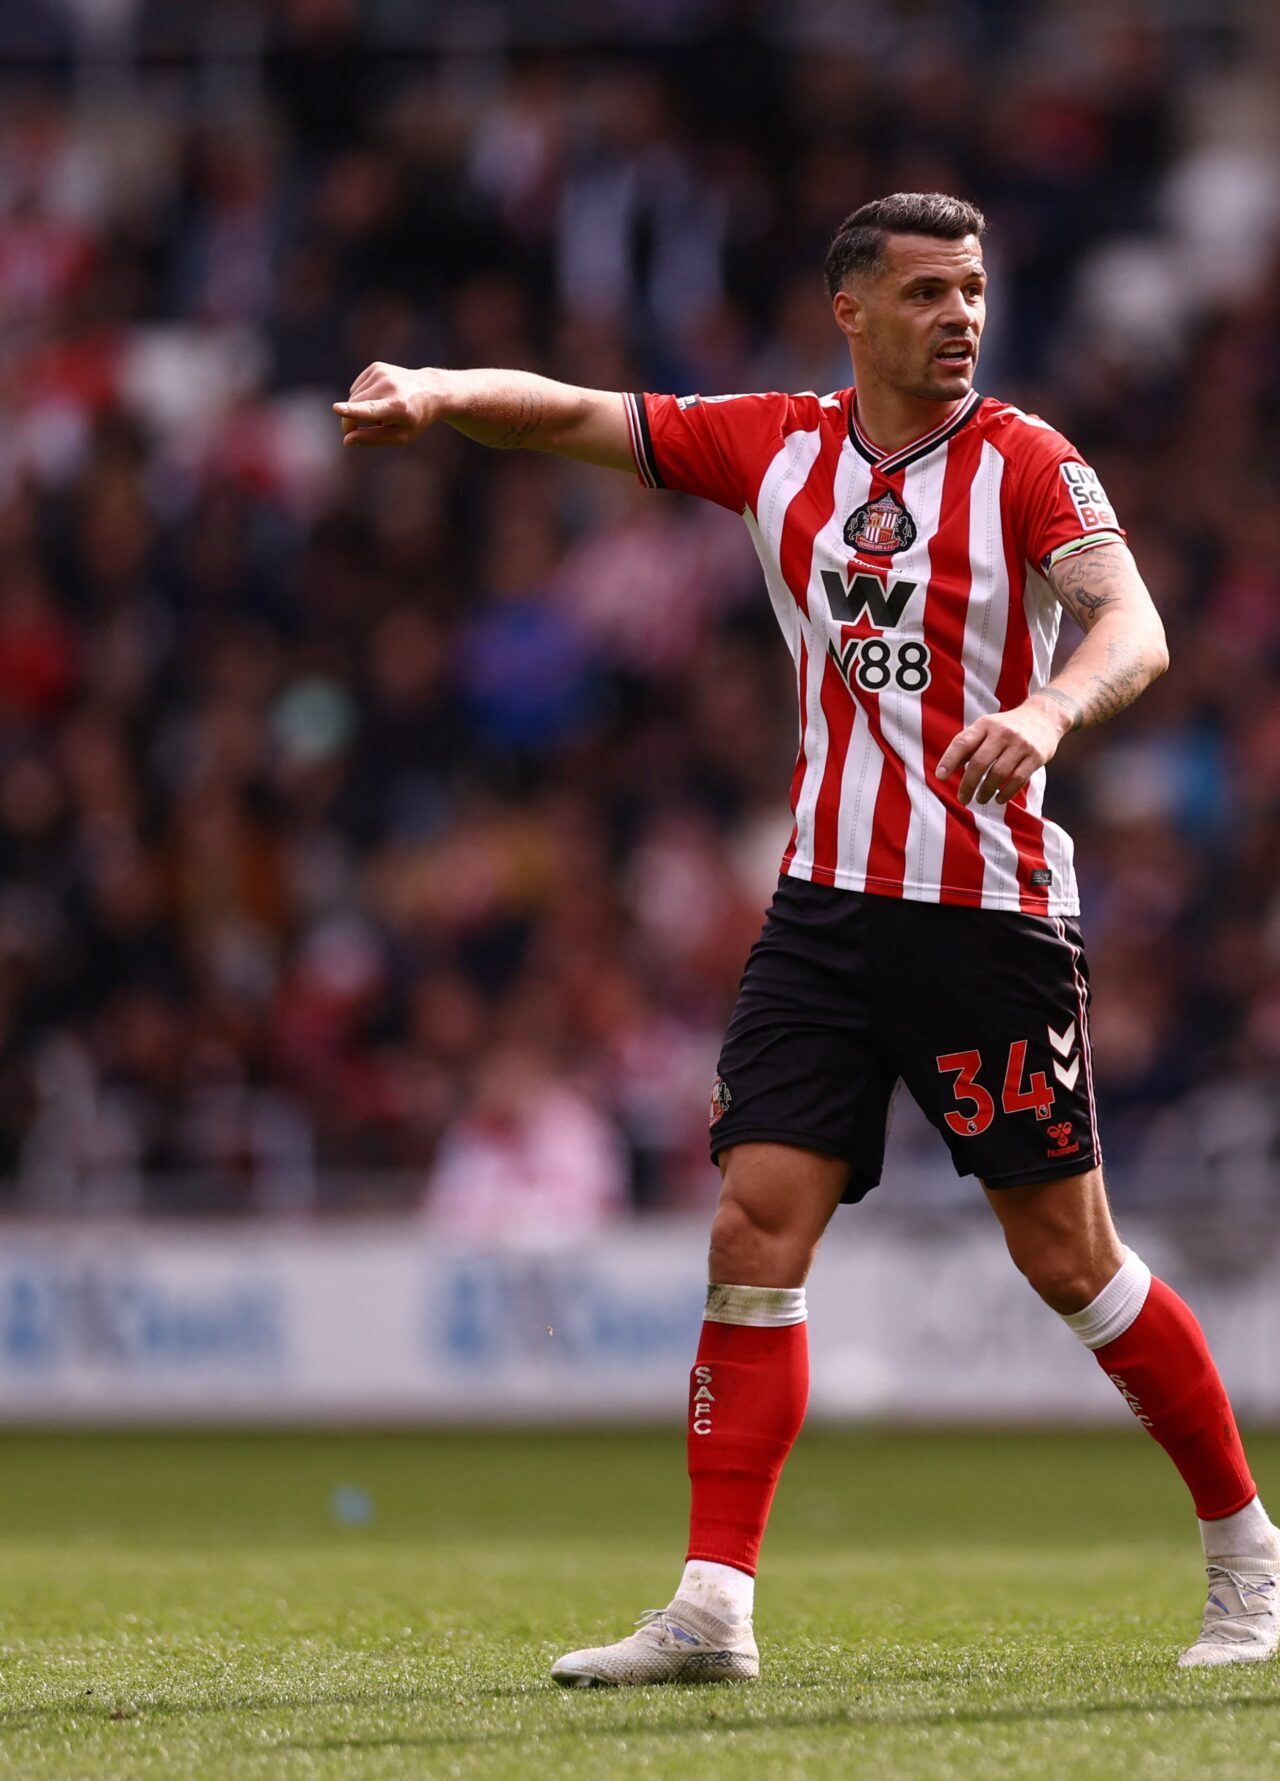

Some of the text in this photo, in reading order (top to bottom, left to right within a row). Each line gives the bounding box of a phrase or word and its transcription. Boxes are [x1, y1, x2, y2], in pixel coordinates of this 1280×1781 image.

[1063, 464, 1095, 484] Liv
[1080, 507, 1113, 527] Be
[820, 569, 917, 628] W
[936, 1039, 1056, 1136] 34
[693, 1366, 715, 1435] SAFC
